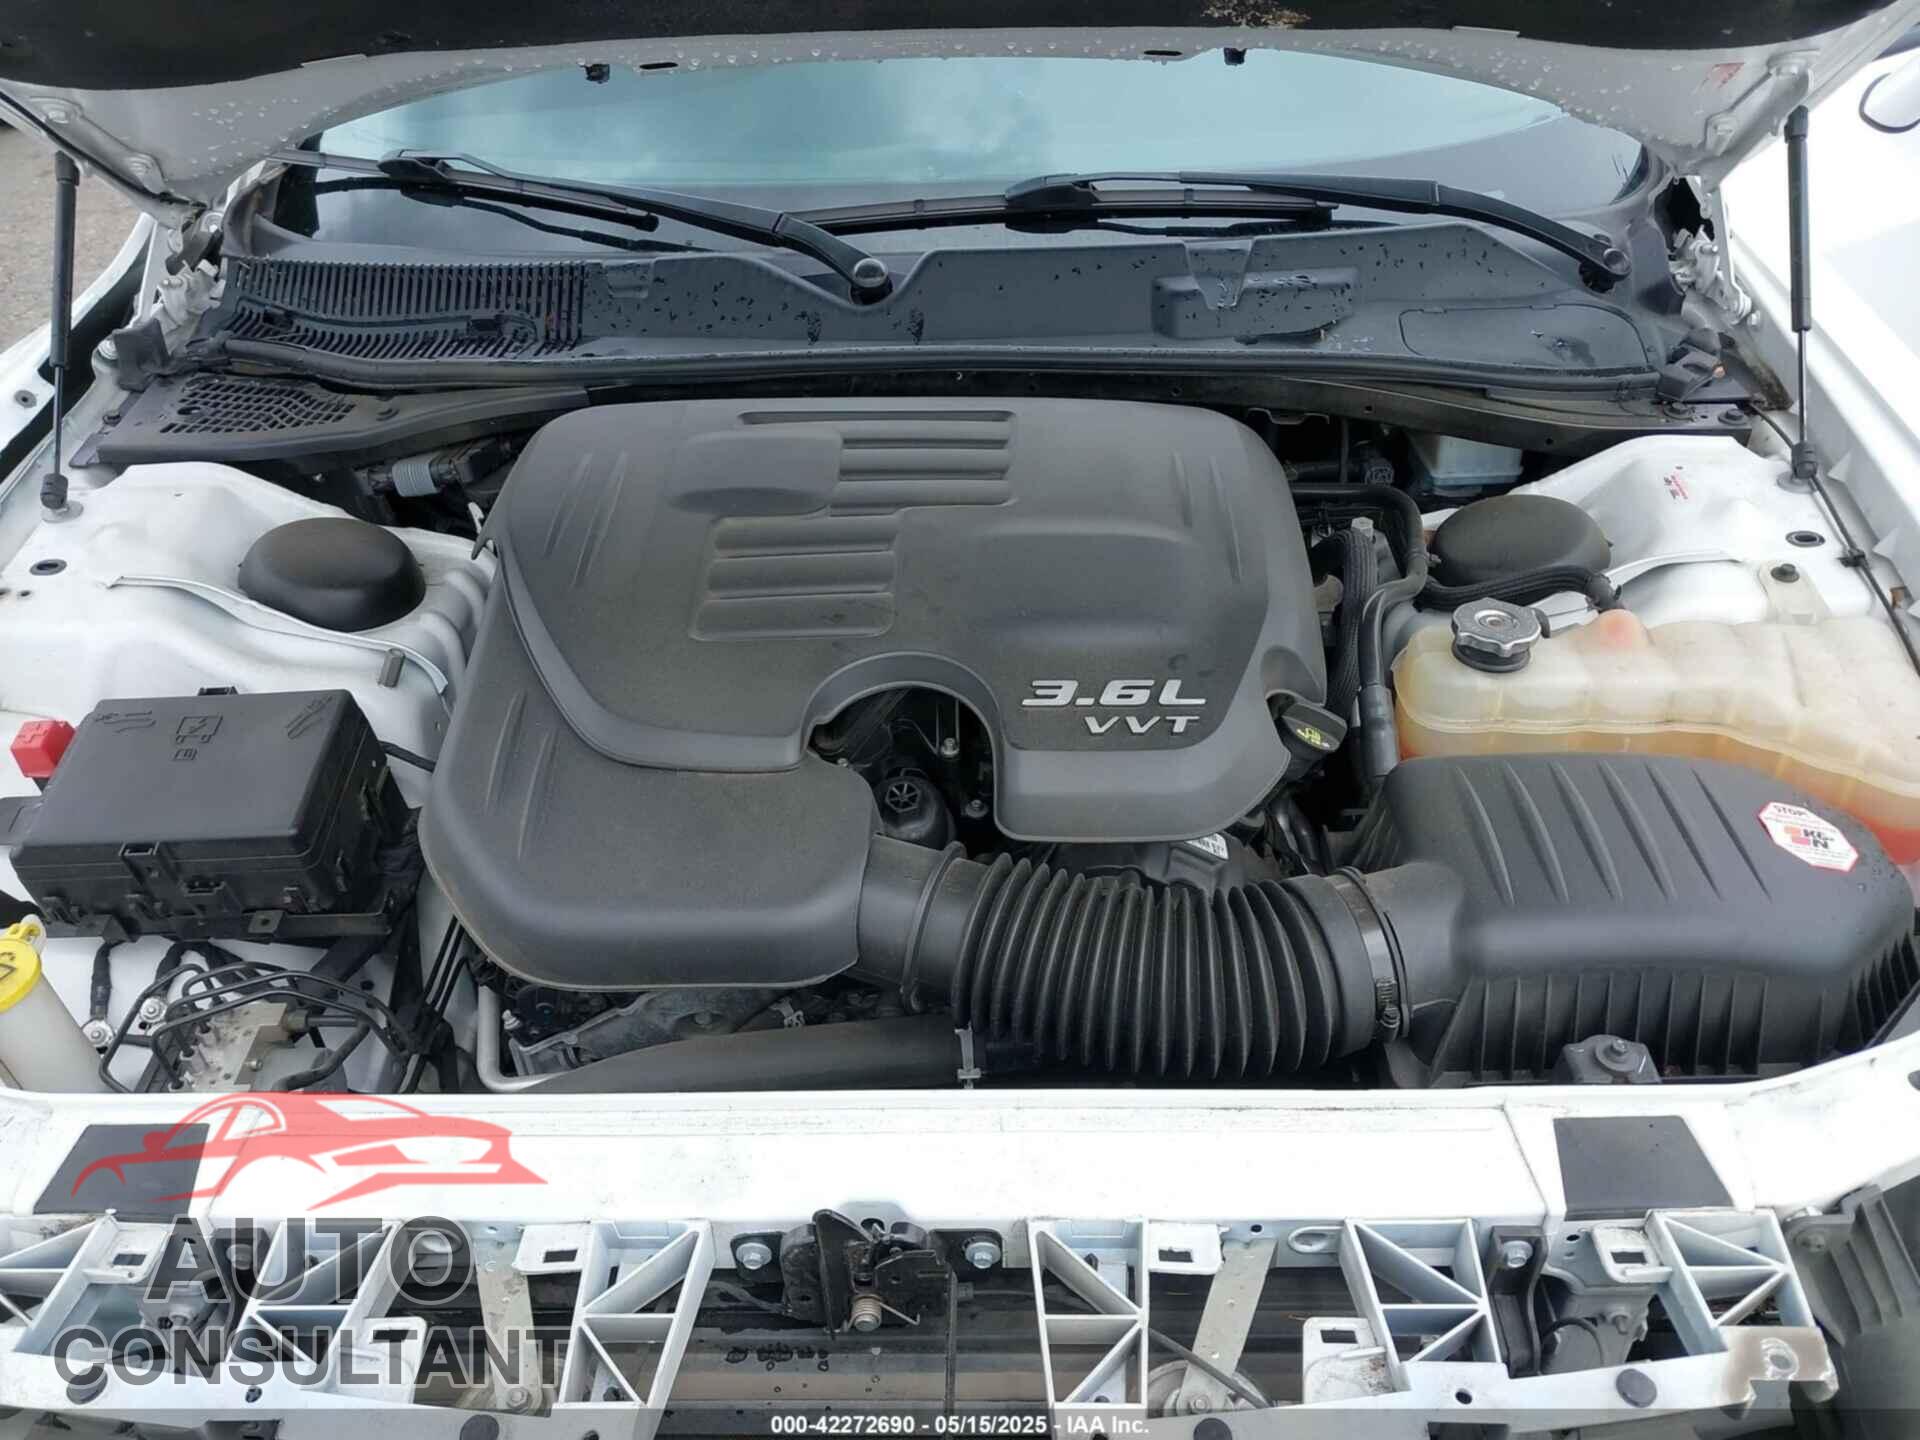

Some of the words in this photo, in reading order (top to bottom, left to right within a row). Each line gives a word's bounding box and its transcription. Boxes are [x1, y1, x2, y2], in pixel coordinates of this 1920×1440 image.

[1021, 679, 1207, 707] 3.6L
[1084, 716, 1200, 735] VVT
[1773, 805, 1808, 817] STOP
